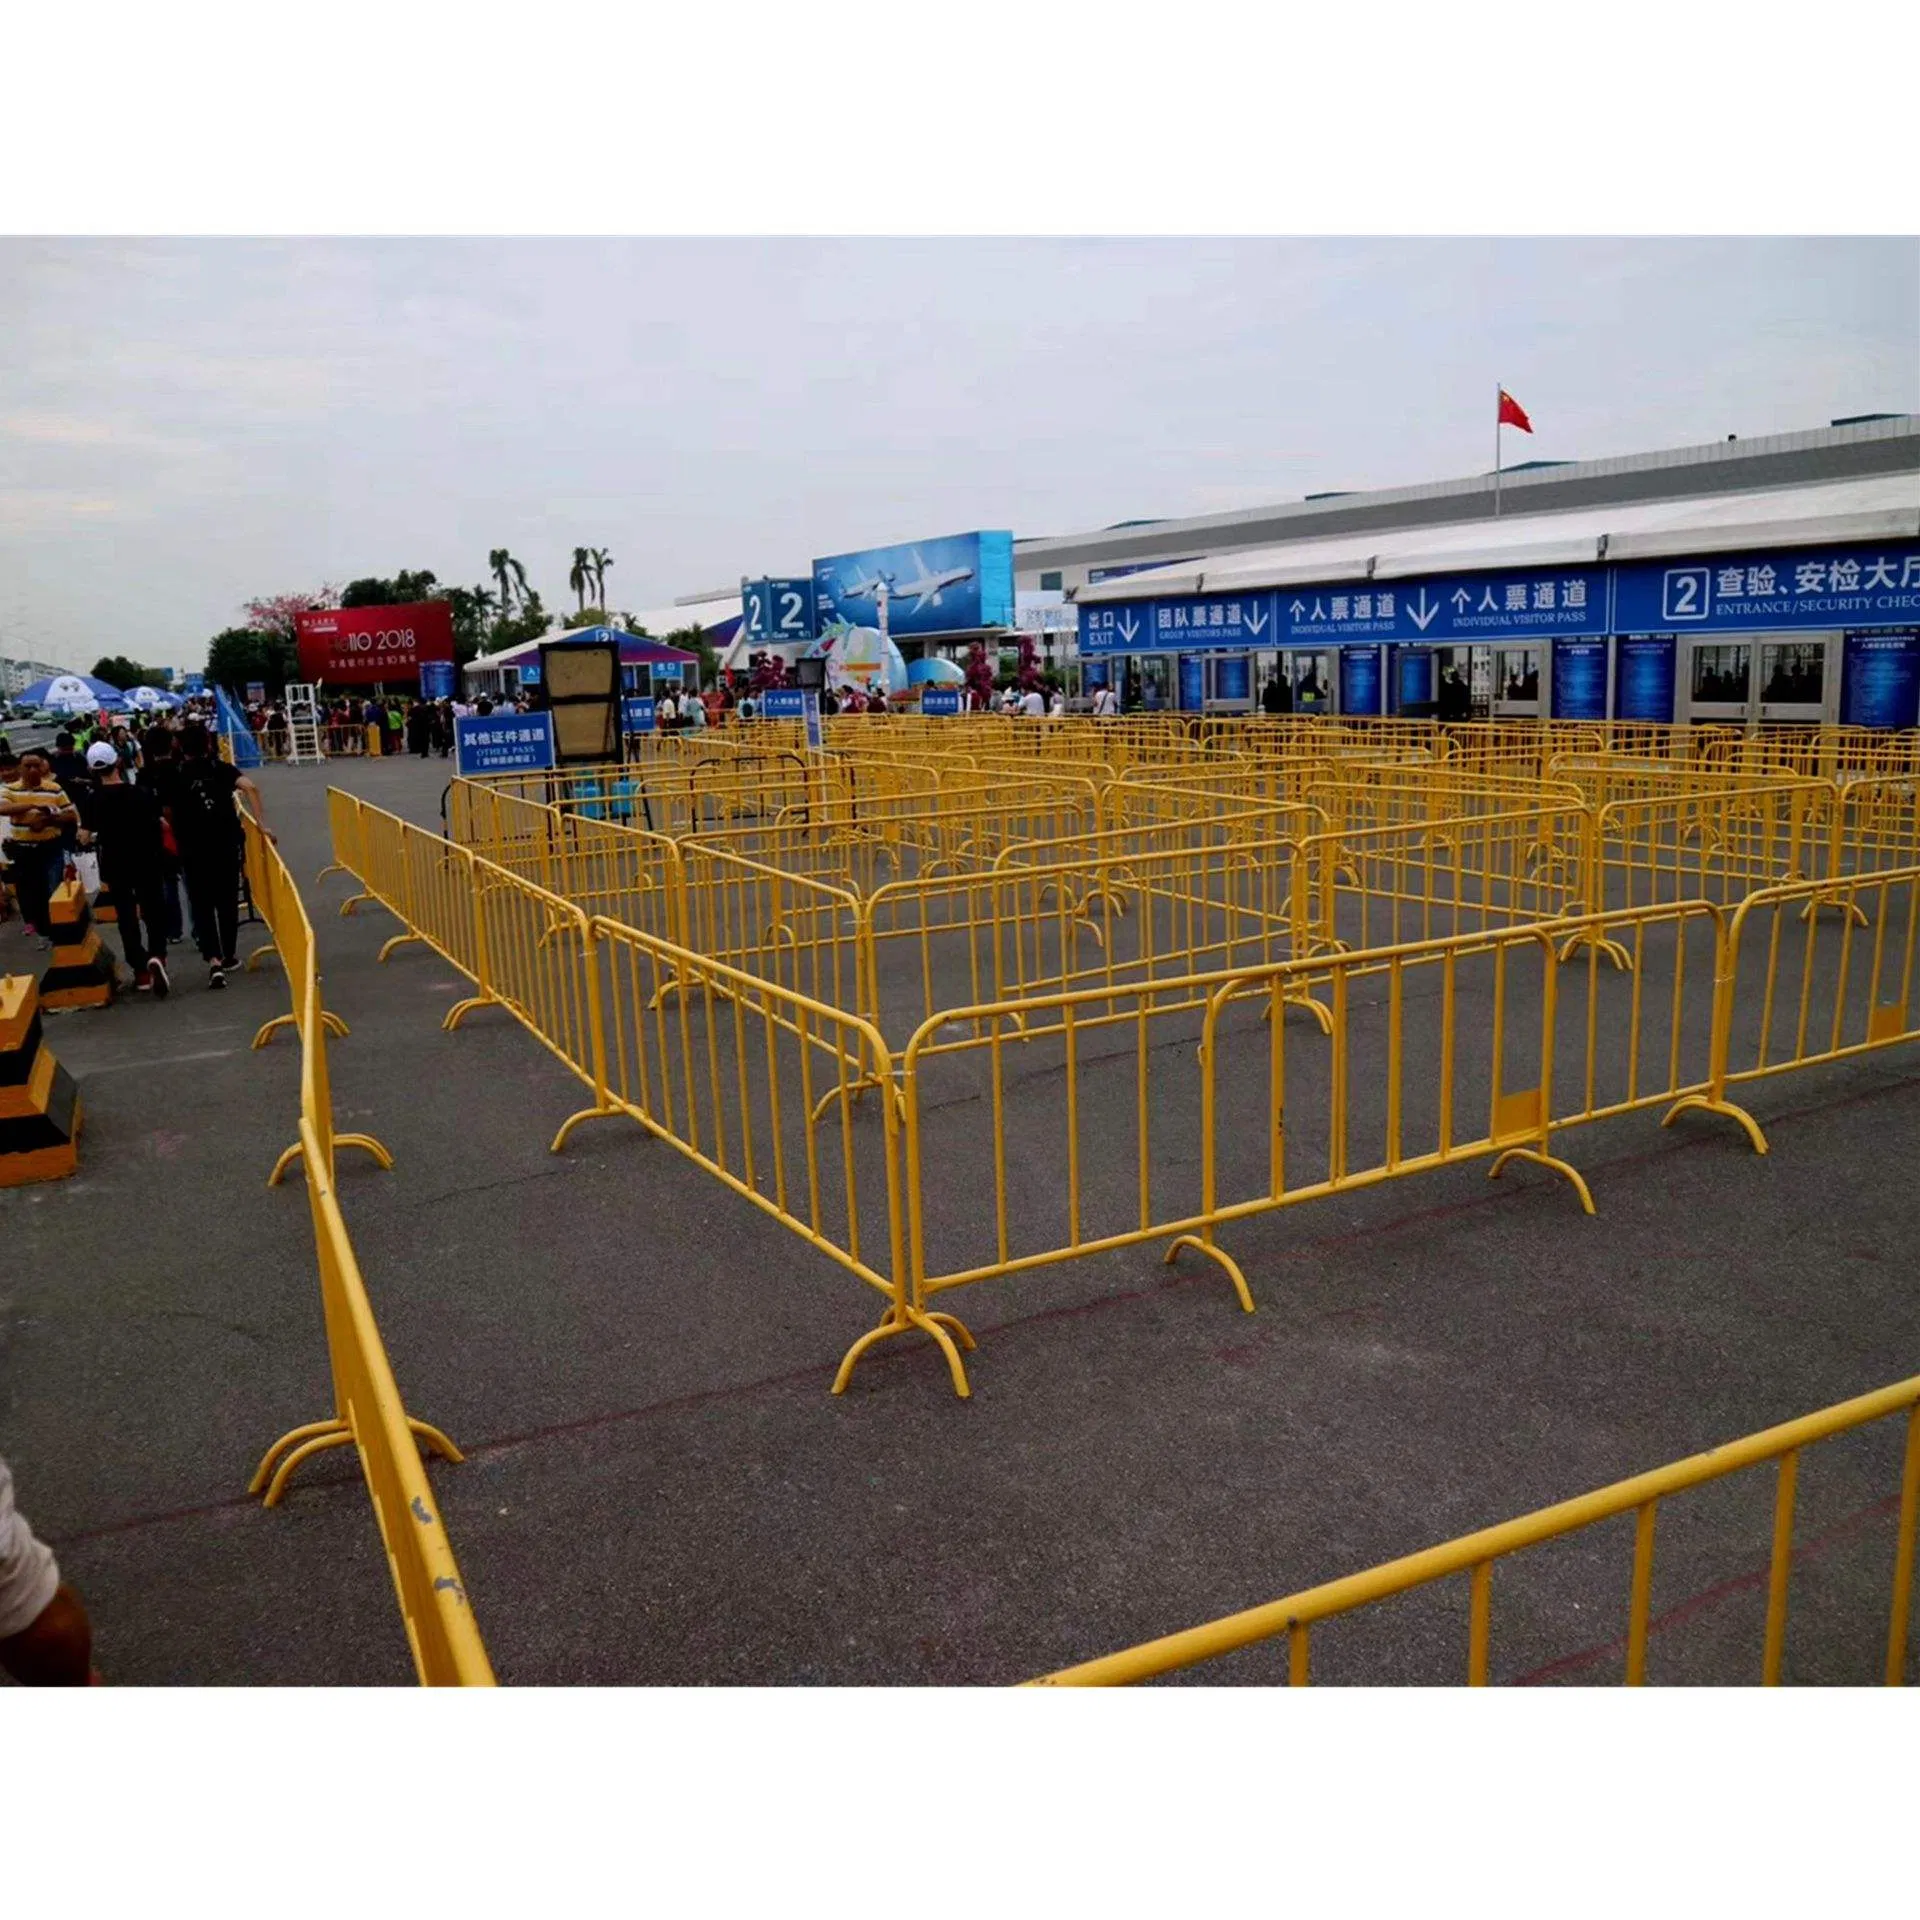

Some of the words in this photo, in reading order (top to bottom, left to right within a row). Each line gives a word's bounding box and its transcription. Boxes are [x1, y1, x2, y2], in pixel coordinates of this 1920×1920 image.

[1451, 579, 1587, 614] 个人票通道
[1674, 575, 1698, 613] 2
[749, 594, 762, 631] 2
[780, 591, 805, 629] 2
[1158, 603, 1242, 629] 团队票通道
[1289, 593, 1396, 622] 个人票通道
[1716, 597, 1873, 616] ENTRANCE/SECURITY
[1088, 611, 1115, 630] 出口
[1290, 623, 1337, 635] INDIVIDUAL
[1338, 621, 1371, 633] VISITOR
[1373, 620, 1396, 631] PASS
[1452, 616, 1512, 628] INDIVIDUAL
[1513, 613, 1556, 625] VISITOR
[1557, 611, 1587, 623] PASS
[376, 628, 416, 650] 2018
[1088, 631, 1114, 646] EXIT
[463, 728, 545, 746] 其他证件通道
